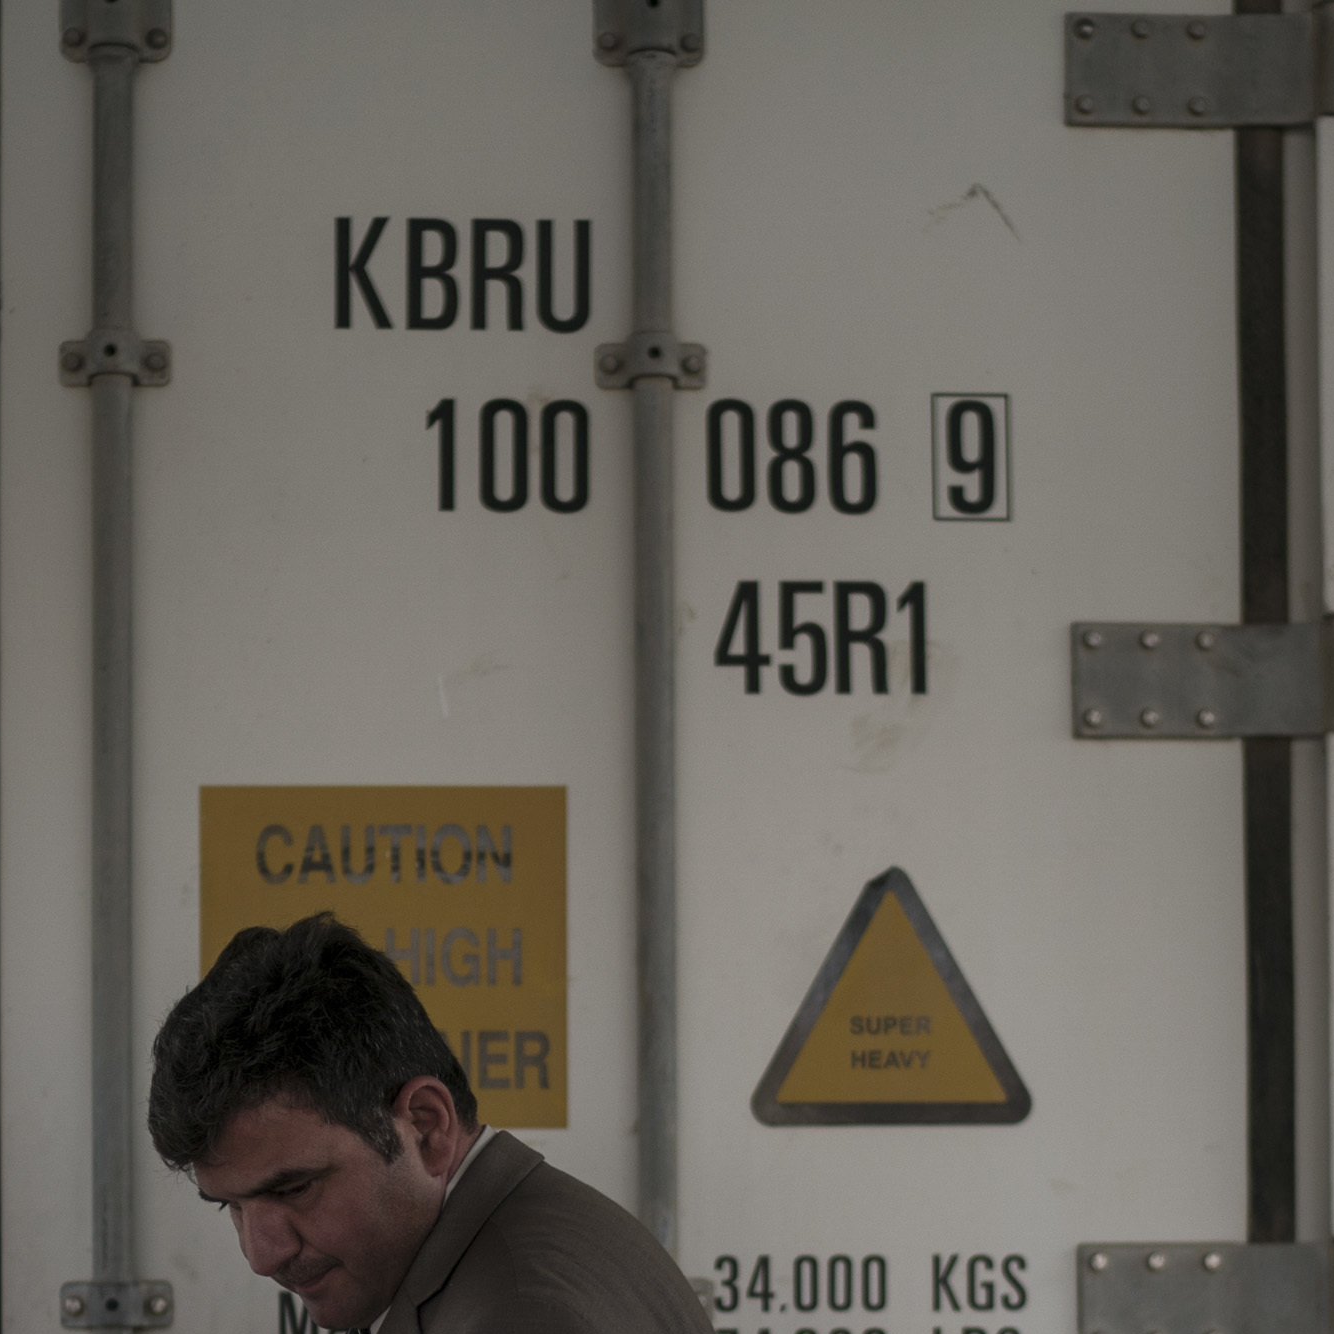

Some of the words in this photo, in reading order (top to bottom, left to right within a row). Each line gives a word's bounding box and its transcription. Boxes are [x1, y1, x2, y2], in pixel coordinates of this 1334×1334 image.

[333, 216, 592, 333] KBRU
[426, 398, 590, 513] 100
[706, 398, 878, 515] 086
[946, 399, 996, 515] 9
[713, 580, 928, 695] 45R1
[255, 824, 515, 885] CAUTION
[384, 927, 523, 987] HIGH
[849, 1014, 932, 1036] SUPER
[849, 1048, 932, 1071] HEAVY
[932, 1254, 1027, 1312] KGS
